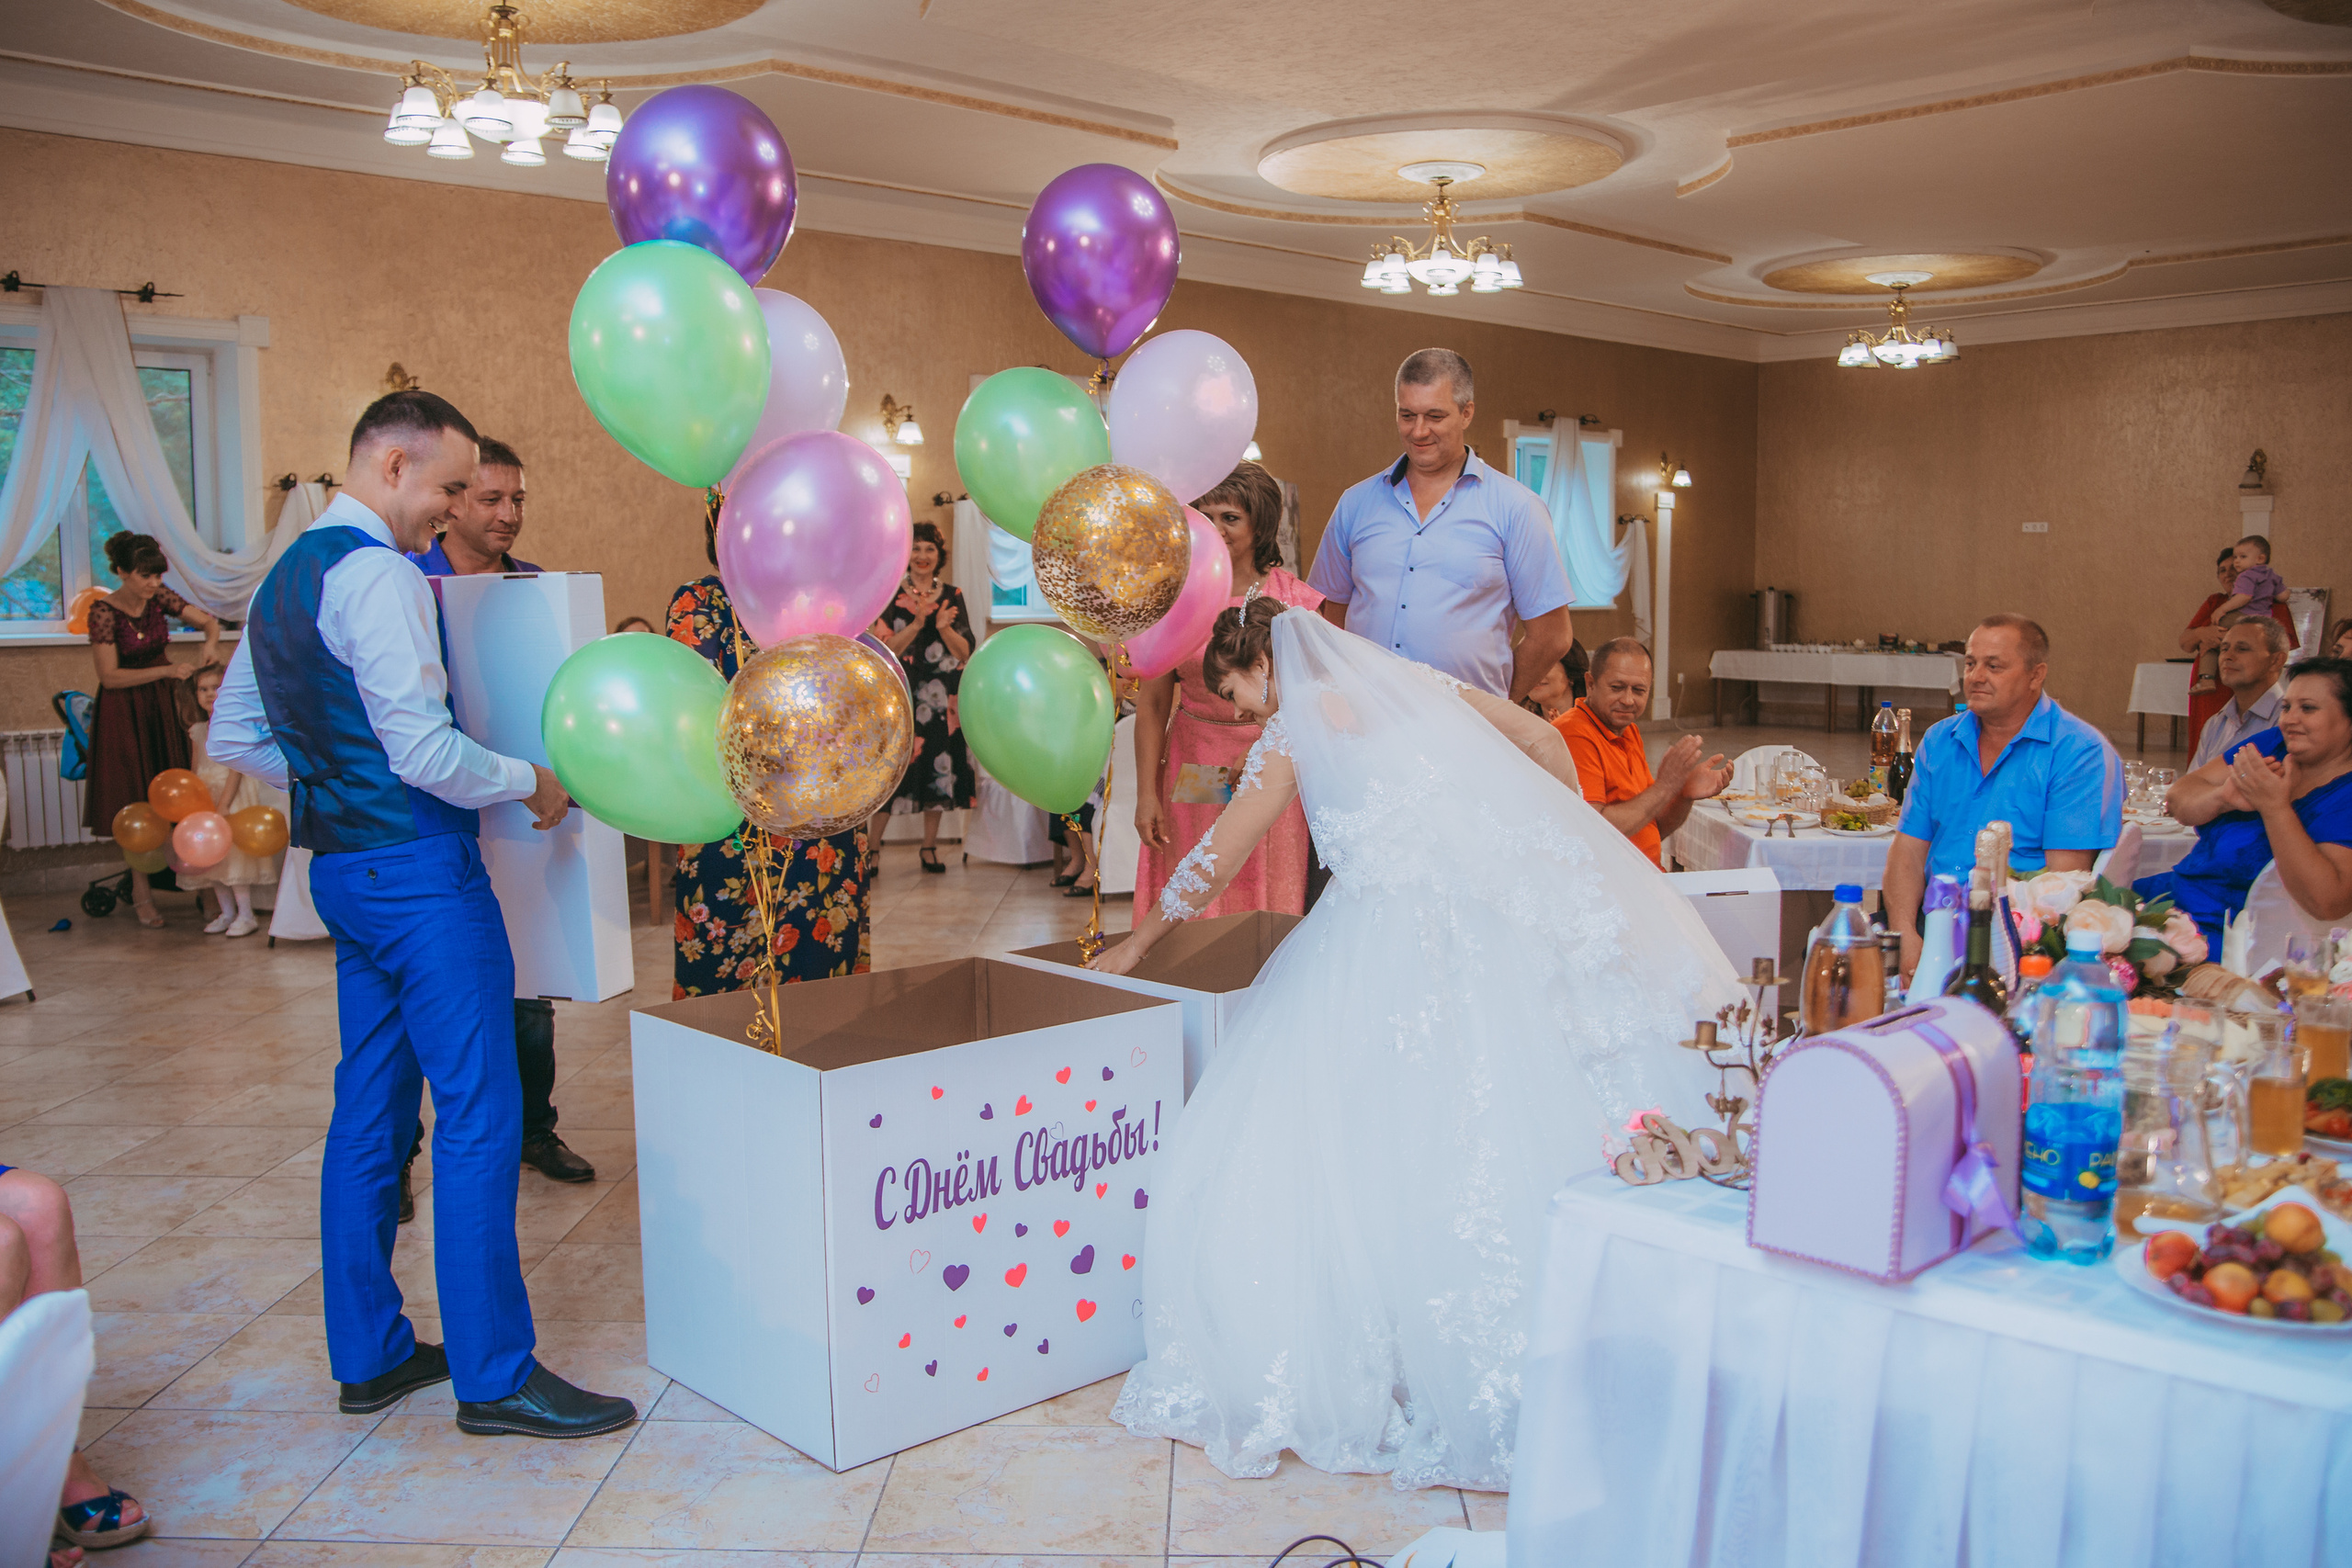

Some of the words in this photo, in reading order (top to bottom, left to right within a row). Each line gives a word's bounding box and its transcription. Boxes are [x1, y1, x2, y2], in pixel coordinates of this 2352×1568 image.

[874, 1167, 897, 1230] С
[903, 1149, 1002, 1224] Днём
[1013, 1100, 1161, 1192] Свадьбы!
[2089, 1152, 2117, 1168] РА
